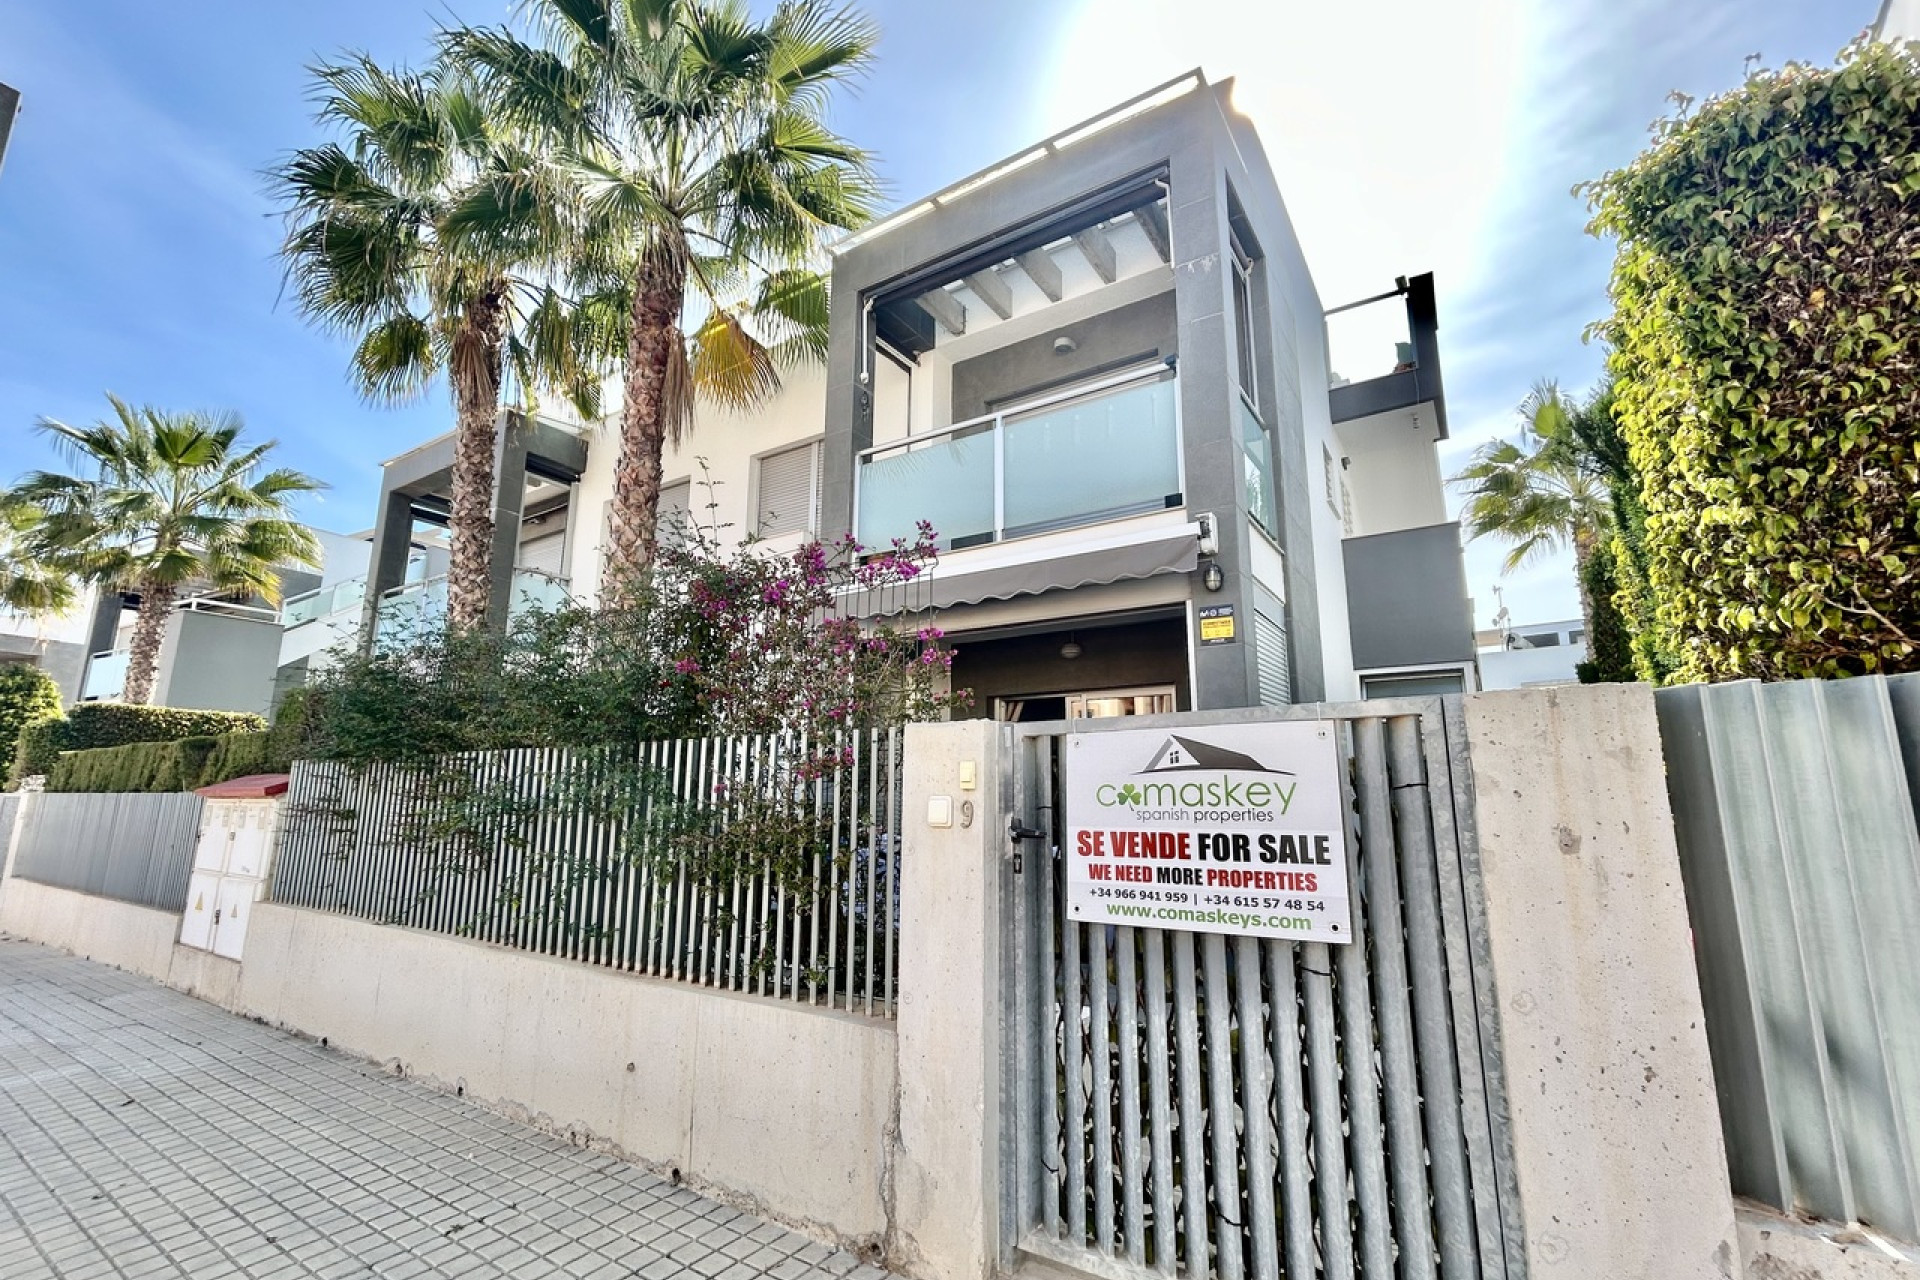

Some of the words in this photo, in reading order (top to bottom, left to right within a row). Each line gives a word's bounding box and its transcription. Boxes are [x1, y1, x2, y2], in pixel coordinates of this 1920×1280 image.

[960, 800, 974, 829] 9
[1136, 808, 1190, 822] spanish
[1194, 808, 1274, 823] properties
[1077, 830, 1105, 857] SE
[1110, 831, 1191, 860] VENDE
[1198, 833, 1251, 863] FOR
[1258, 834, 1331, 866] SALE
[1088, 863, 1112, 880] WE
[1115, 865, 1153, 883] NEED
[1156, 866, 1204, 886] MORE
[1207, 868, 1318, 893] PROPERTIES
[1090, 887, 1112, 898] +34
[1114, 888, 1136, 899] 966
[1139, 890, 1162, 902] 941
[1165, 892, 1188, 903] 959
[1204, 894, 1230, 906] +34
[1234, 896, 1259, 908] 615
[1263, 898, 1280, 909] 57
[1284, 899, 1303, 911] 48
[1307, 900, 1325, 912] 54
[1107, 903, 1312, 931] www.comaskeys.com
